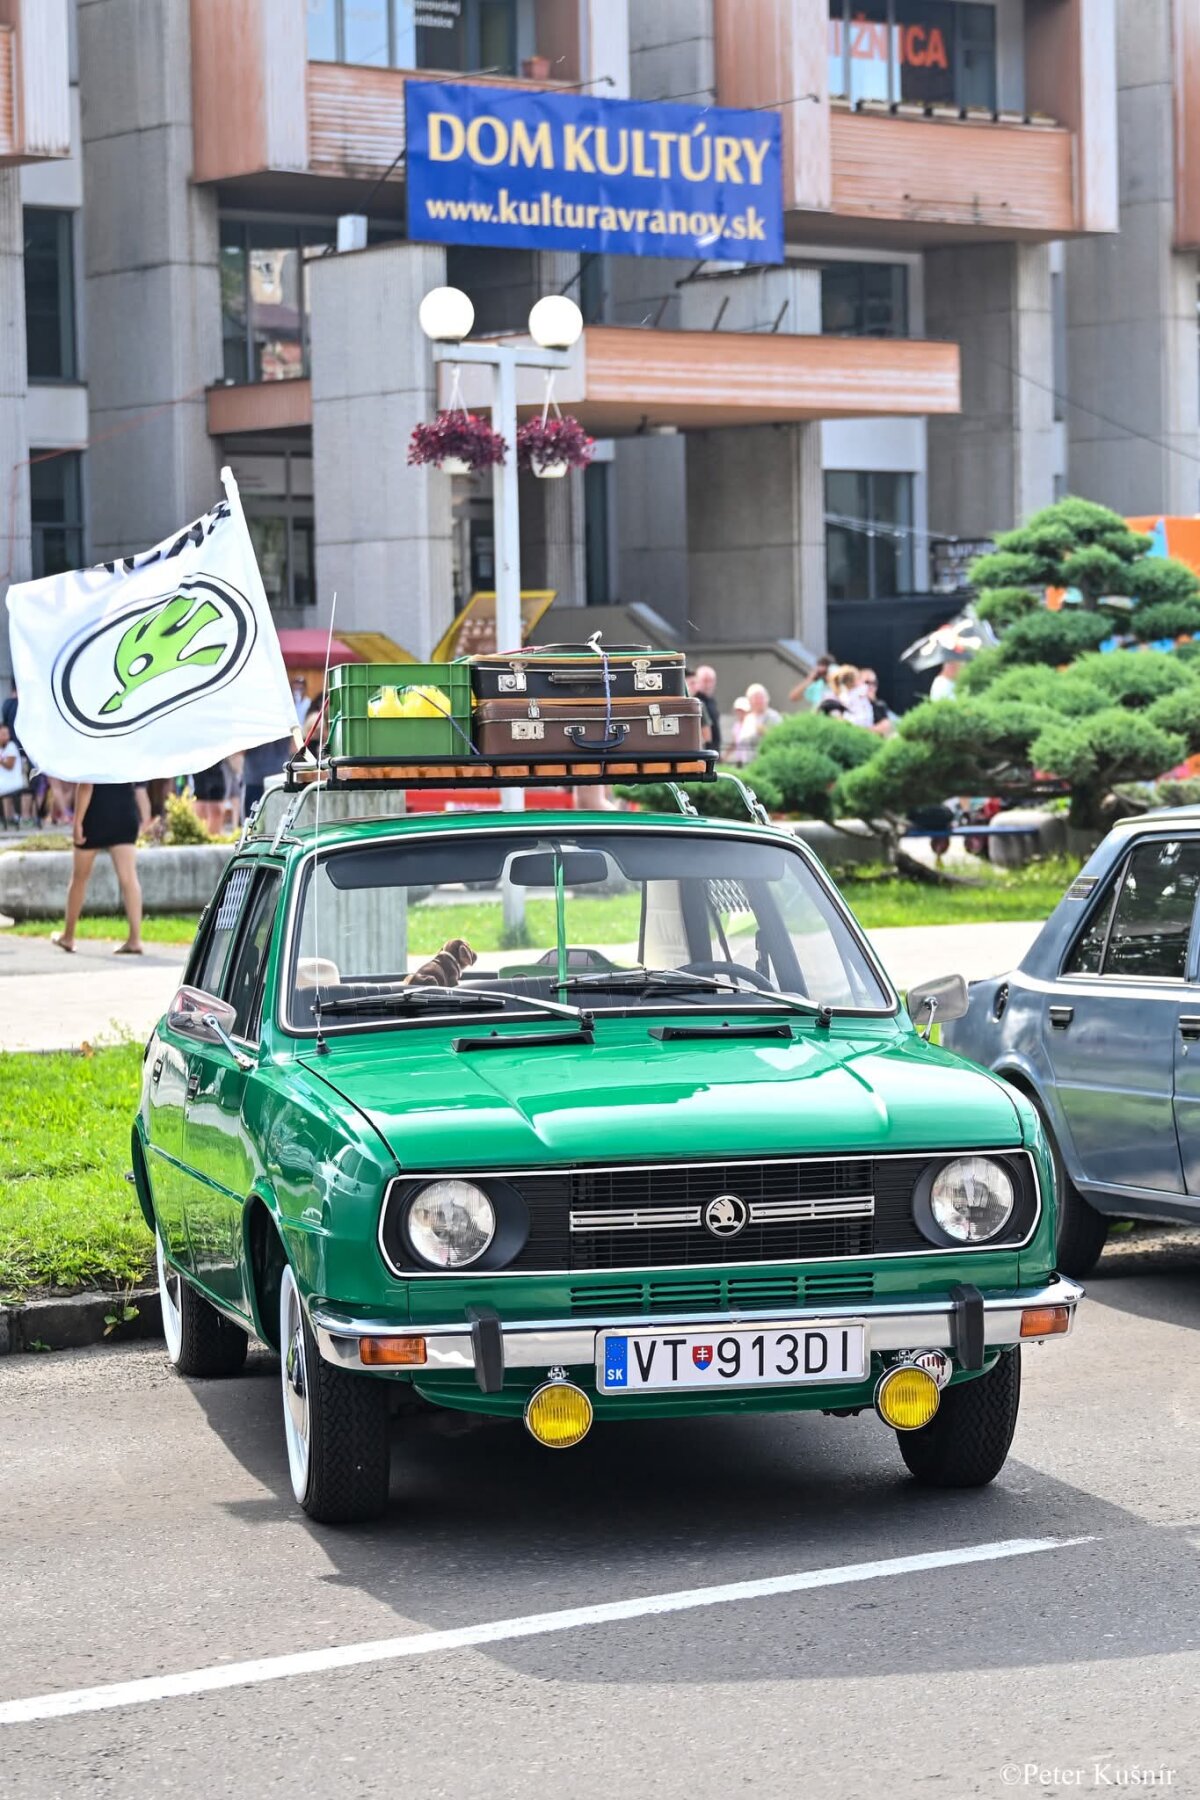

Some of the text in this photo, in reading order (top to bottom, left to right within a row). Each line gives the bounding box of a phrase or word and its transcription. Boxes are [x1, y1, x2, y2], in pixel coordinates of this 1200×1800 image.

[427, 112, 770, 185] DOM KULTÚRY
[607, 1368, 623, 1380] SK
[633, 1330, 849, 1382] VT 913DI
